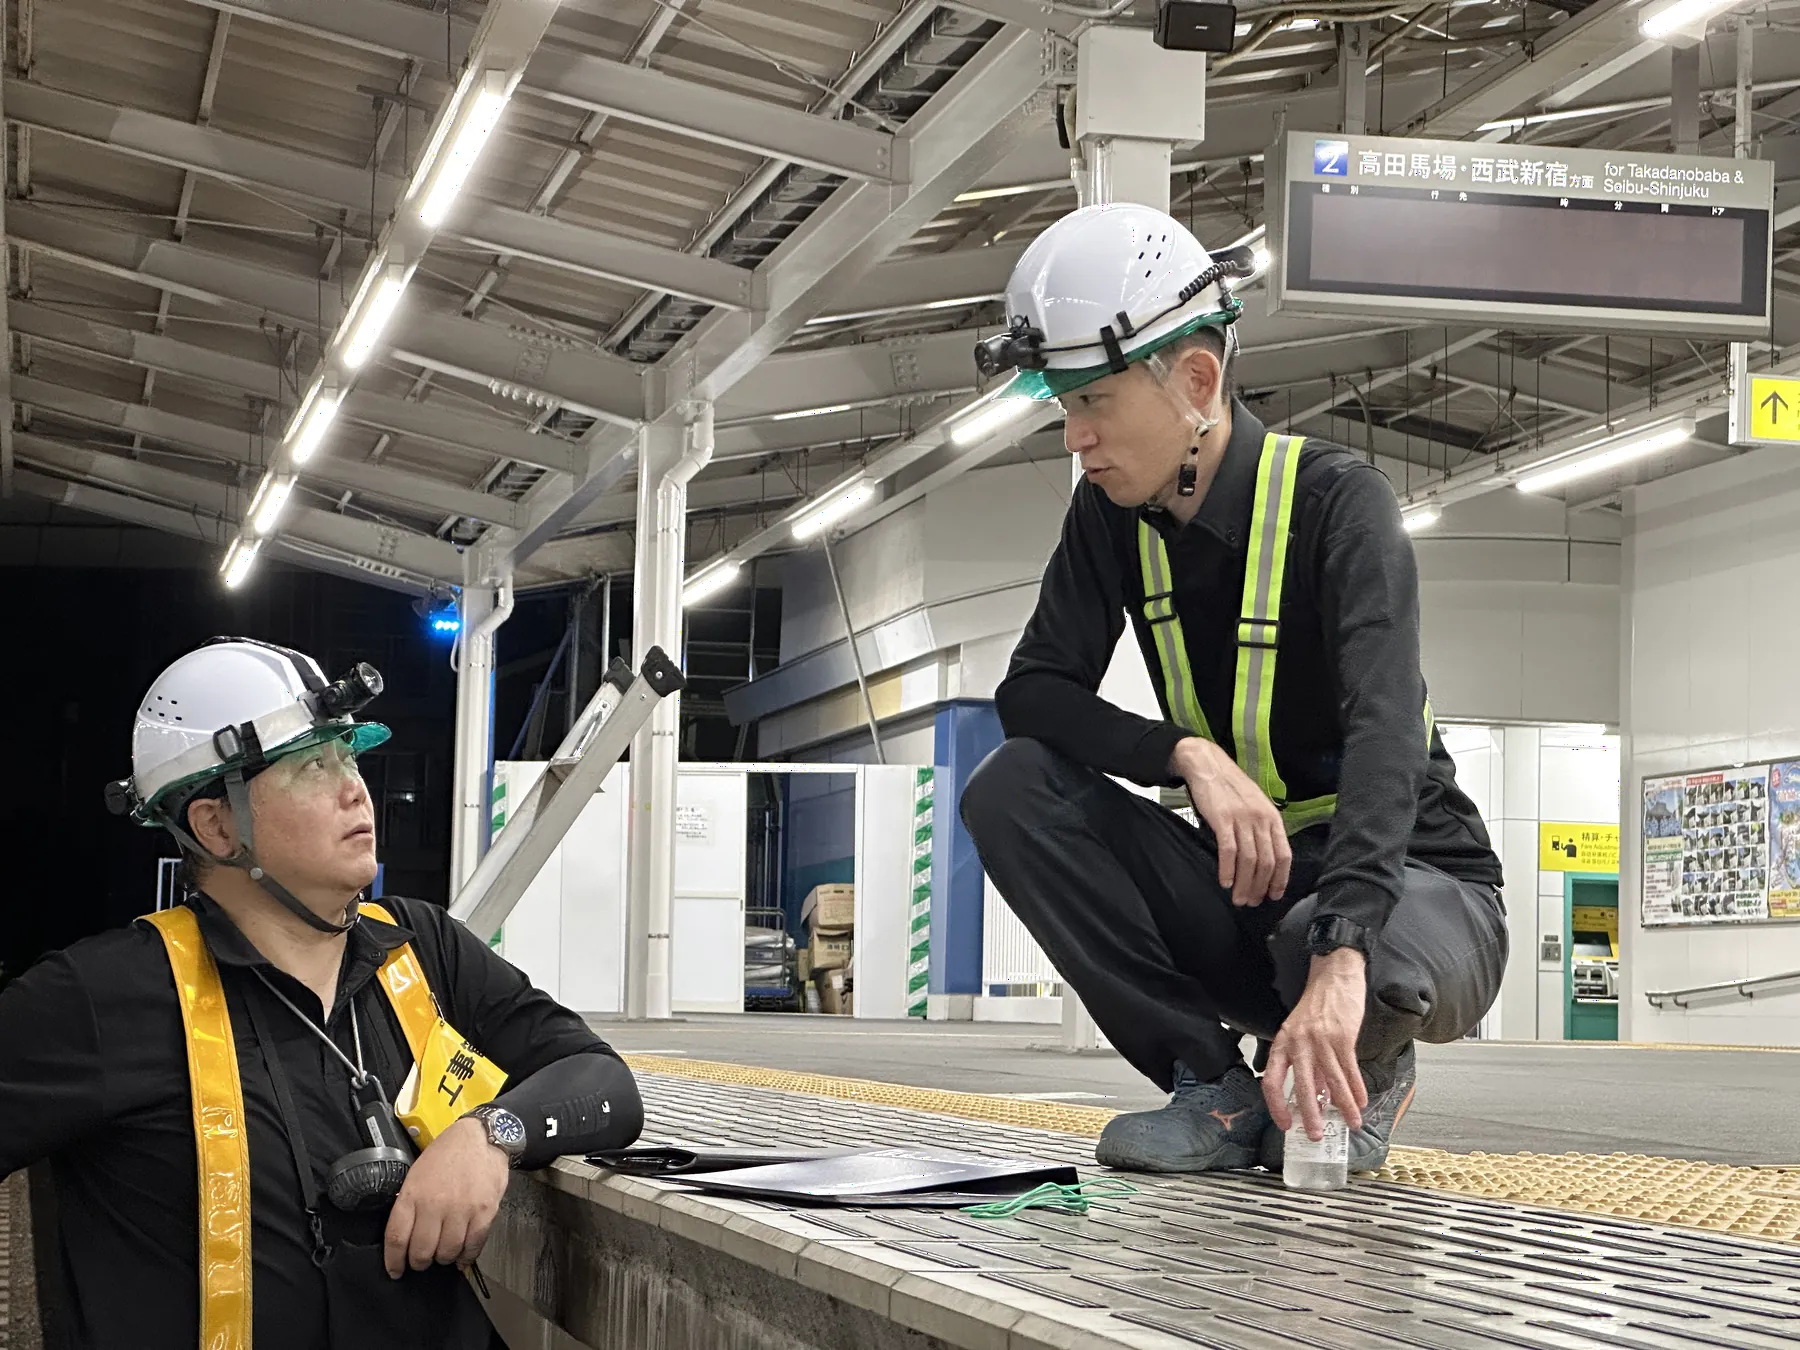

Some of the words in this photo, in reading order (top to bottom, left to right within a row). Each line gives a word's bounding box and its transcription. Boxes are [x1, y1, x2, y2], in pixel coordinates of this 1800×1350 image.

[1321, 146, 1341, 173] 2
[1604, 162, 1625, 177] for
[1627, 163, 1730, 184] Takadanobaba
[1734, 170, 1745, 185] &
[1603, 178, 1710, 200] Seibu-Shinjuku
